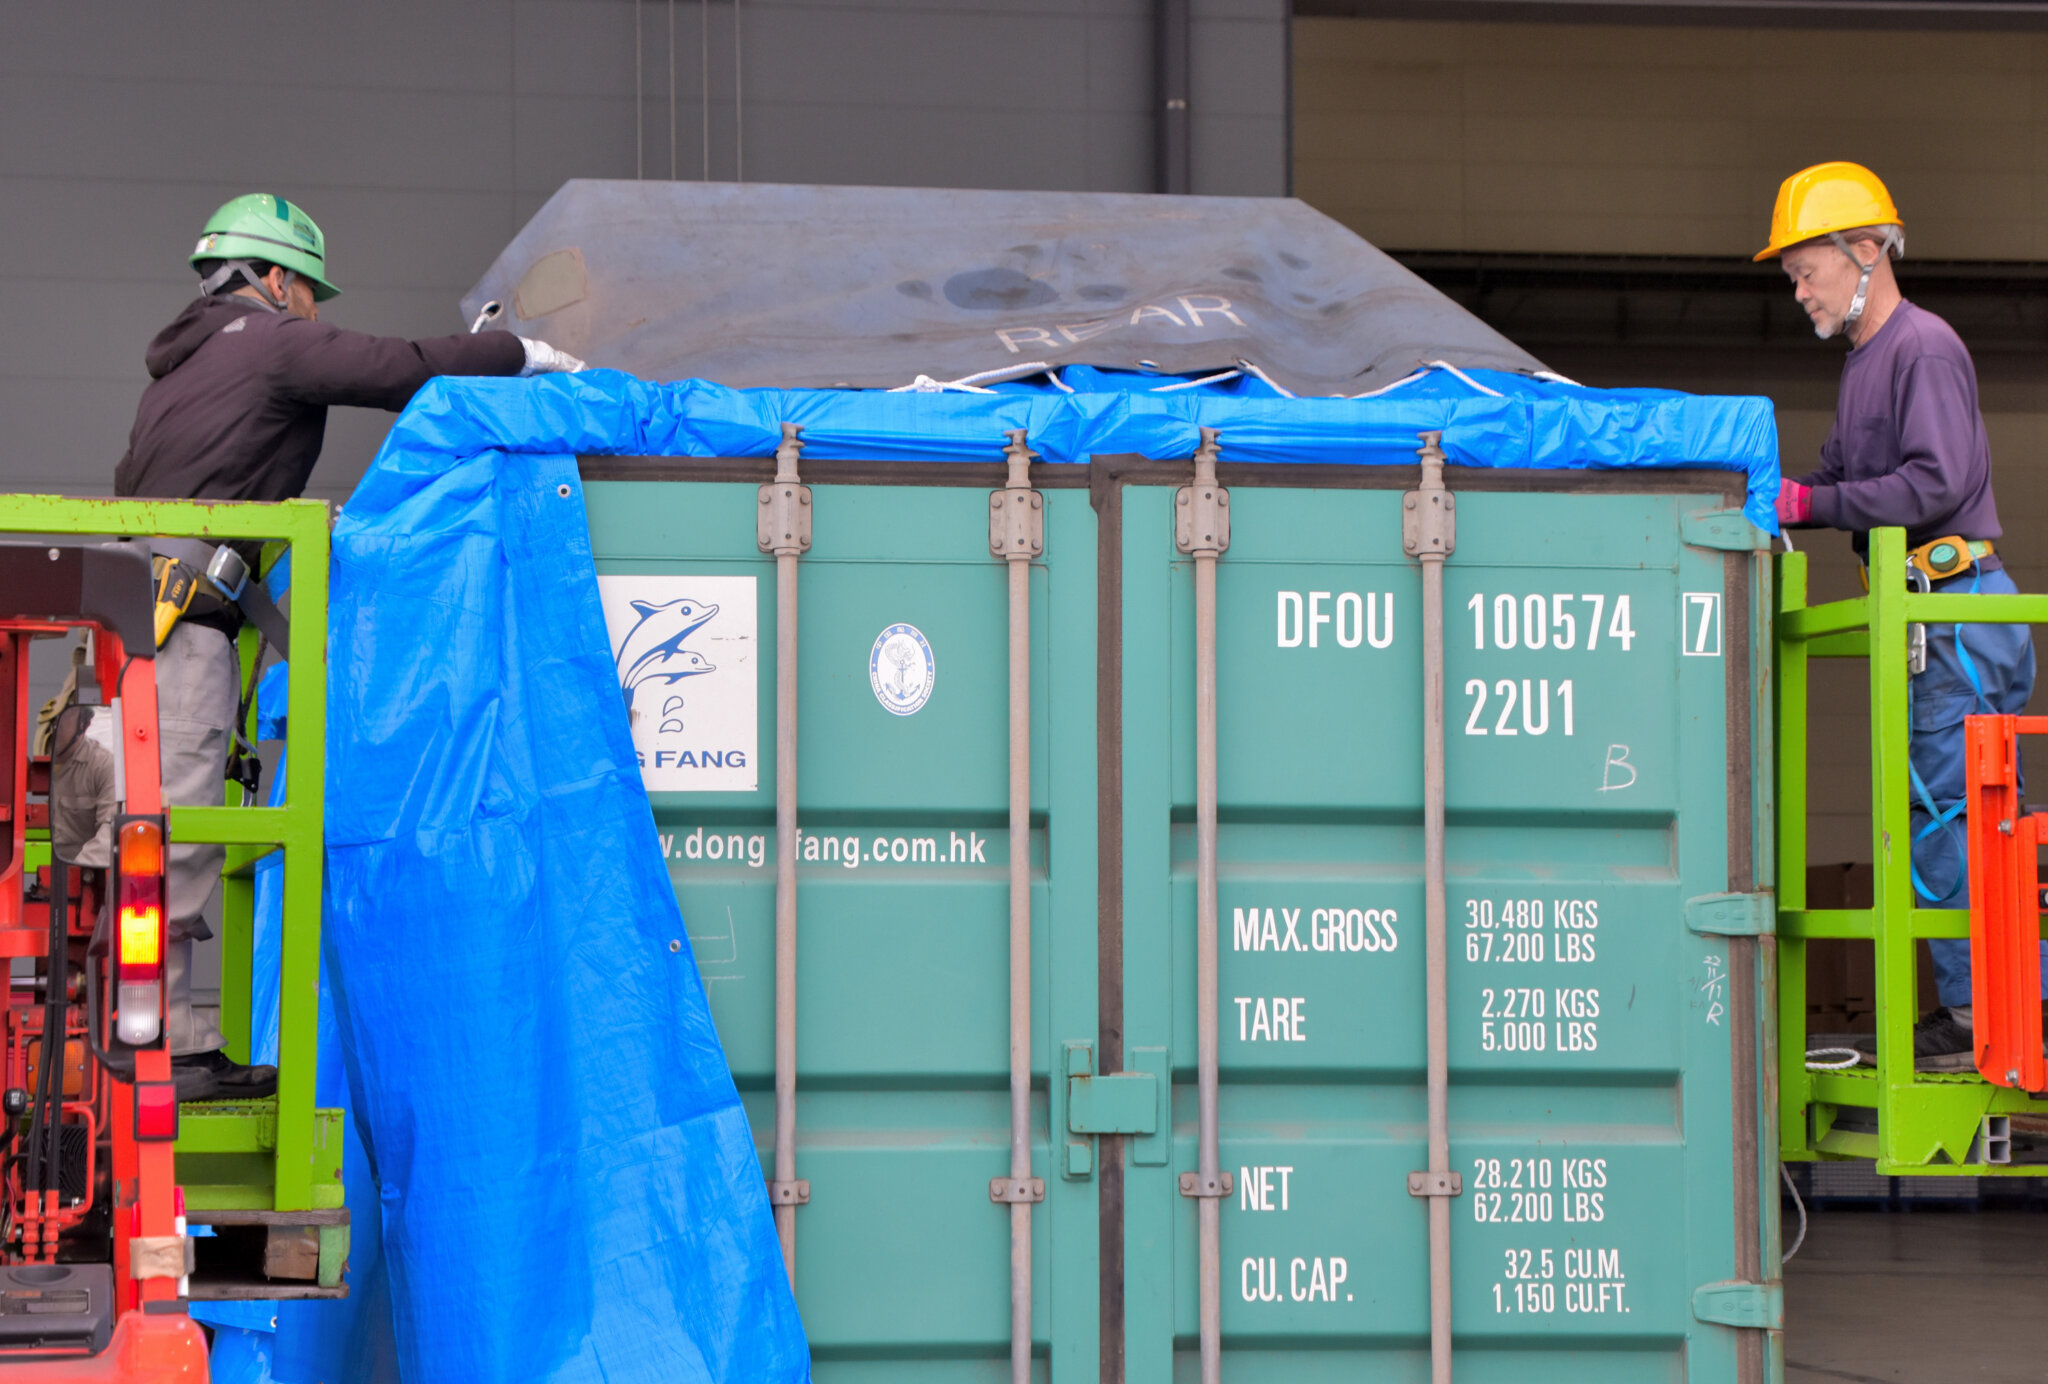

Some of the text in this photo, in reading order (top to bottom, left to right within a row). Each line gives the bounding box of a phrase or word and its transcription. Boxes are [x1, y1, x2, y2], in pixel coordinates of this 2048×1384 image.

[994, 294, 1247, 353] REAR
[1277, 591, 1713, 652] DFOU 100574 7
[1465, 679, 1574, 736] 22U1
[655, 750, 746, 768] FANG
[1597, 743, 1637, 792] B
[1233, 908, 1398, 952] MAX.GROSS
[1554, 899, 1598, 929] KGS
[1554, 933, 1596, 963] LBS
[1234, 997, 1306, 1042] TARE
[1555, 988, 1600, 1018] KGS
[1556, 1021, 1598, 1052] LBS
[1240, 1166, 1294, 1211] NET
[1562, 1158, 1607, 1188] KGS
[1563, 1192, 1605, 1222] LBS
[1241, 1257, 1354, 1302] CU. CAP.
[1504, 1248, 1625, 1279] 32.5 CU.M.
